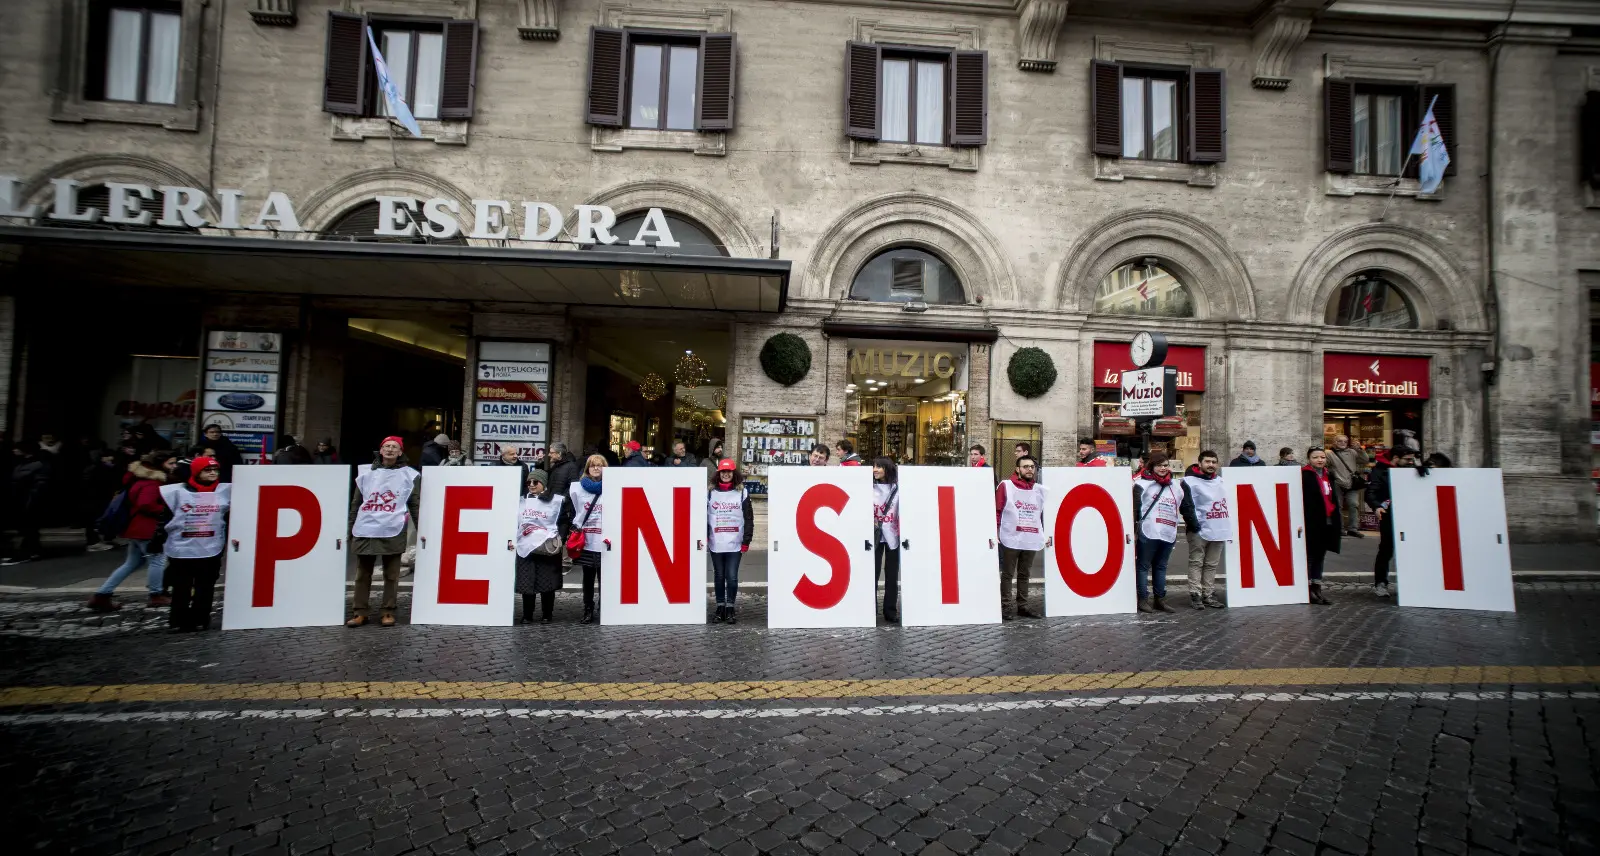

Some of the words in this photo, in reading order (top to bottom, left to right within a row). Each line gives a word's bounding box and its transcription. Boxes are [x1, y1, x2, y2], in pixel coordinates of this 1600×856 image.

[374, 195, 681, 248] ESEDRA
[976, 344, 987, 354] 77
[496, 365, 547, 374] MITSUKOSHI
[851, 348, 956, 379] MUZIO
[214, 372, 269, 384] DAGNINO
[1104, 369, 1118, 384] la
[1332, 378, 1346, 393] la
[1347, 379, 1418, 396] Feltrinelli
[482, 404, 540, 415] DAGNINO
[481, 423, 540, 435] DAGNINO
[257, 484, 1461, 608] PENSIONI
